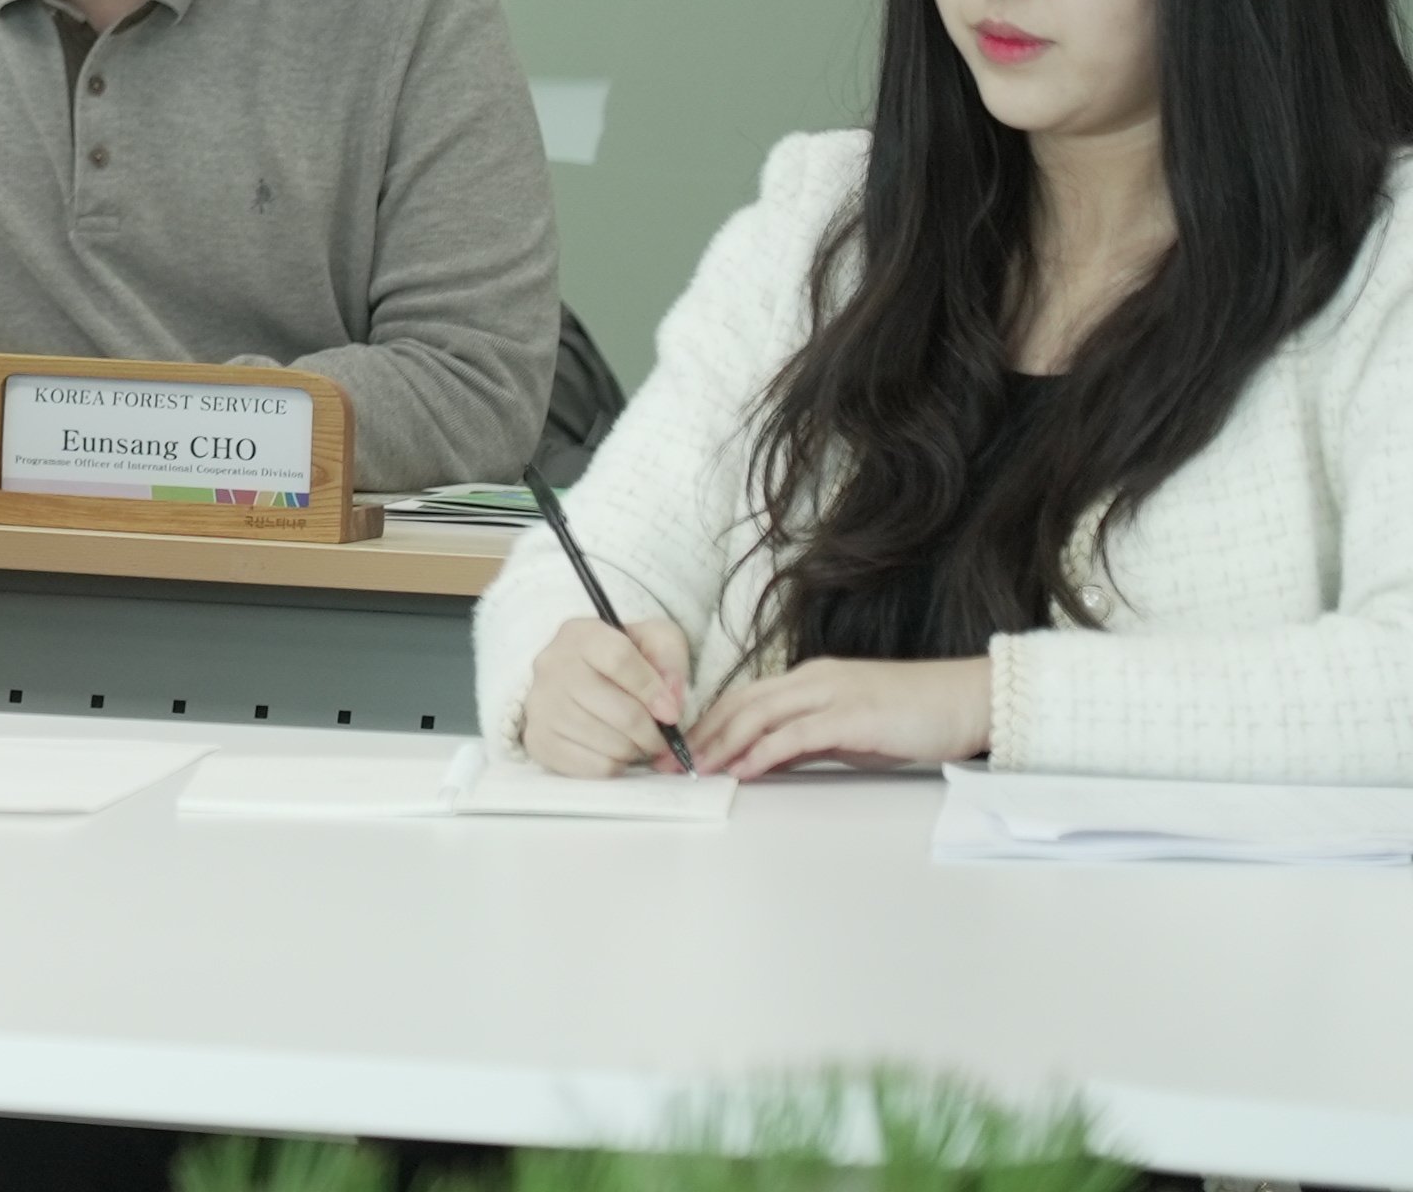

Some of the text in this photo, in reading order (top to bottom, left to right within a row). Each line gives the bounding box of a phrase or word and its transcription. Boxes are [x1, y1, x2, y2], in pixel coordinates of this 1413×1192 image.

[34, 387, 288, 415] KOREA FOREST SERVICE
[61, 428, 257, 461] Eunsang CHO
[15, 455, 304, 479] Programme Officer of International Cooperation Division
